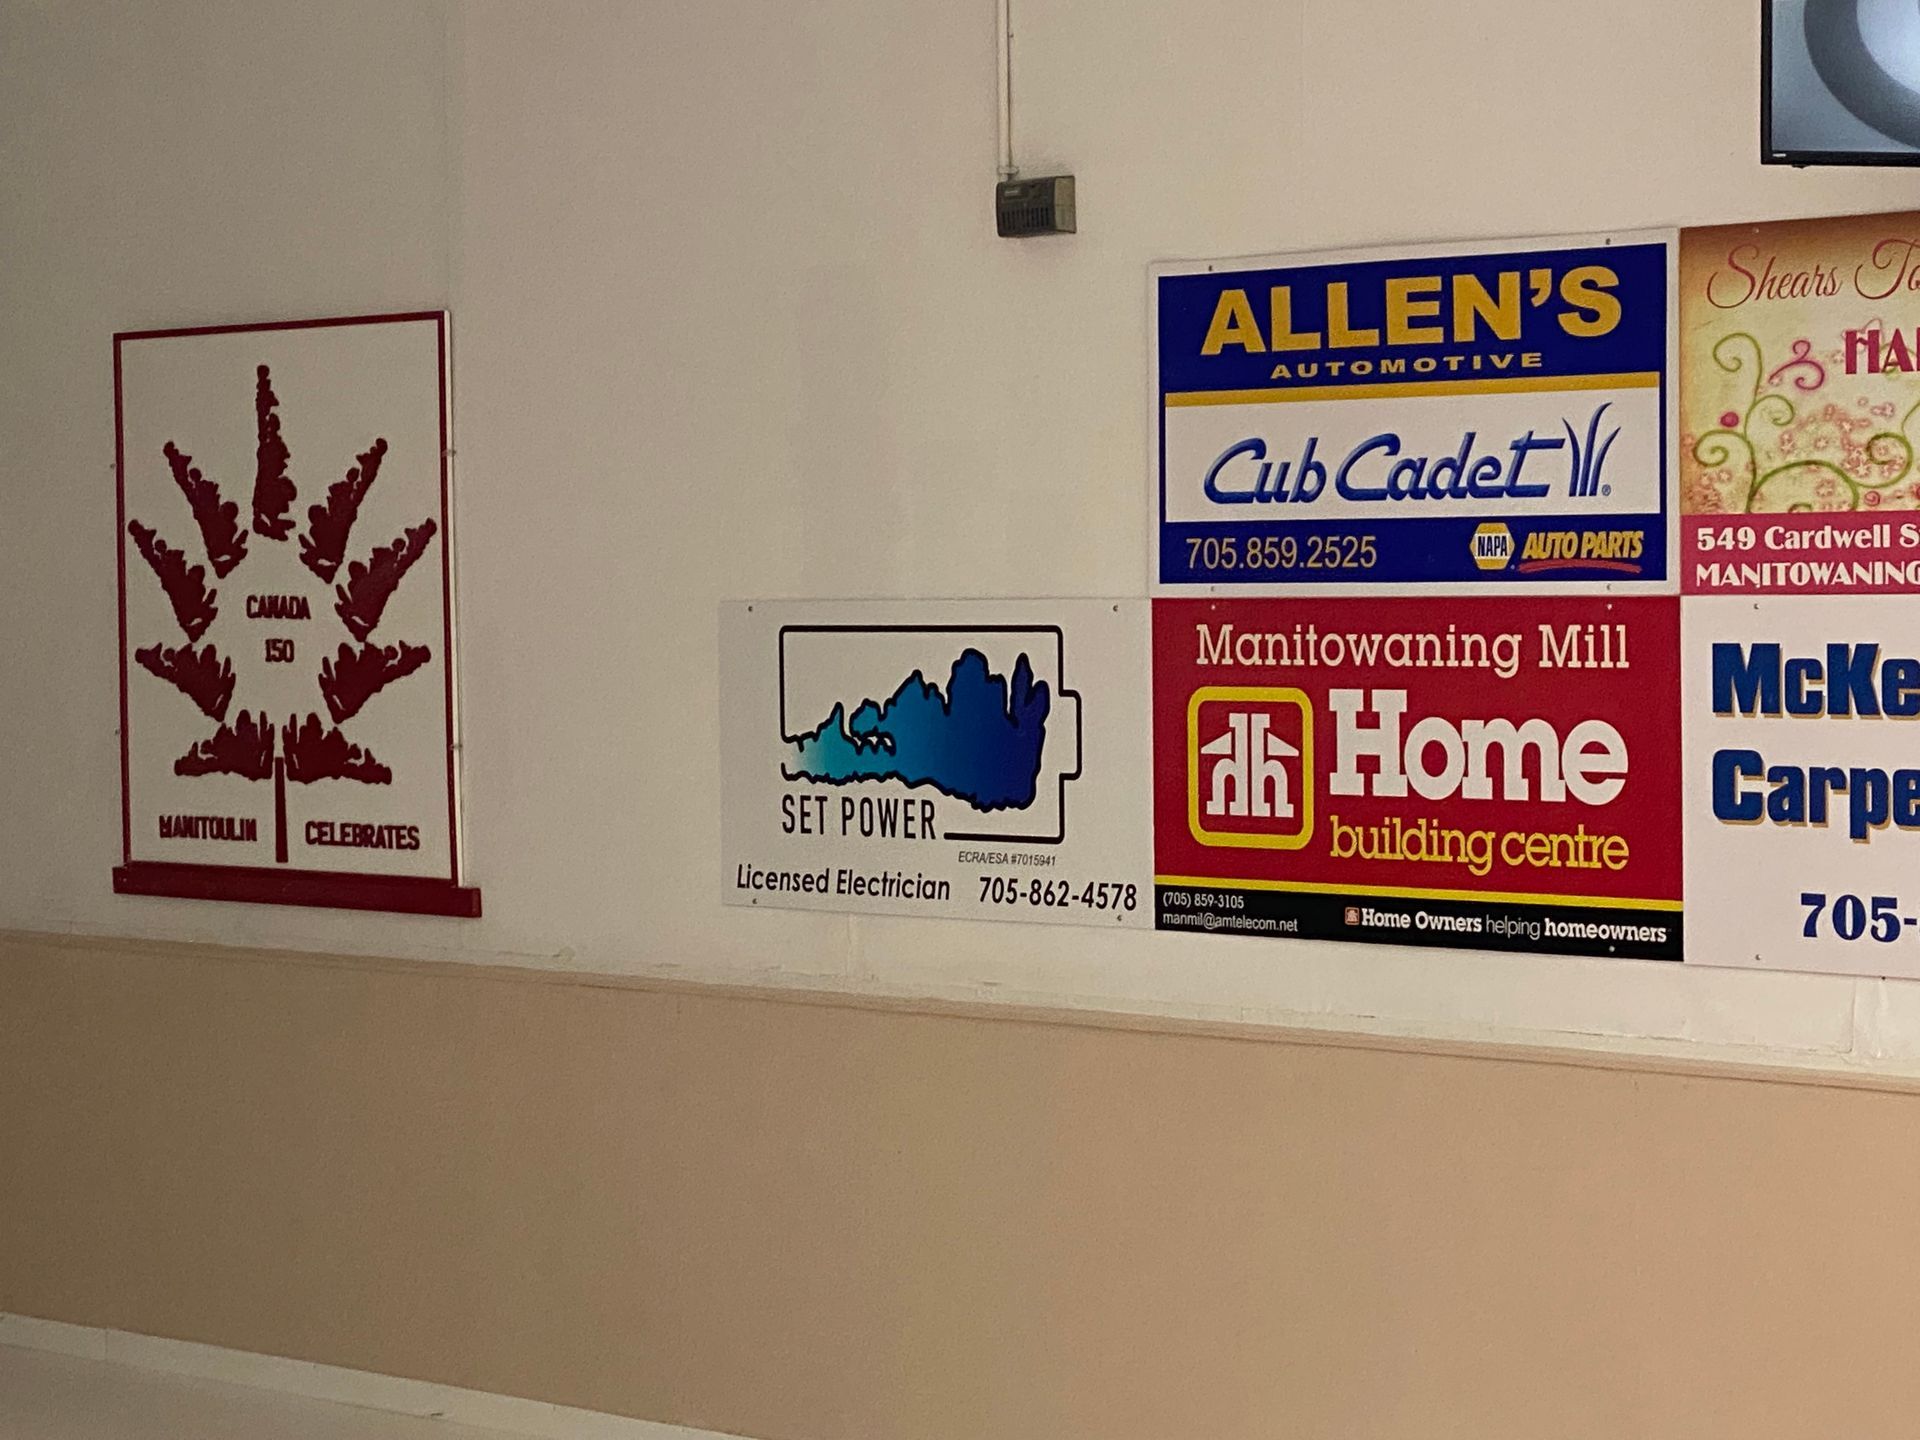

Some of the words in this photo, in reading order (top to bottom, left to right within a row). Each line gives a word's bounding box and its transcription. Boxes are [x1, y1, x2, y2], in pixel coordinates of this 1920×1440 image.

[1707, 244, 1843, 309] Shears
[1200, 265, 1623, 356] ALLEN'S
[1270, 352, 1543, 380] AUTOMOTIVE
[1844, 326, 1920, 375] HA
[1203, 437, 1327, 504] Cub
[1334, 430, 1566, 501] Cadet
[1186, 536, 1377, 569] 705.859.2525
[1477, 535, 1508, 557] NAPA
[1521, 532, 1579, 560] AUTO
[1580, 530, 1645, 559] PARTS
[1696, 527, 1756, 551] 549
[1764, 524, 1891, 550] Cardwell
[1899, 523, 1920, 548] S
[246, 595, 311, 620] CANADA
[265, 639, 295, 662] 150
[1196, 624, 1522, 678] Manitowaning
[1539, 624, 1629, 669] Mill
[1712, 643, 1920, 720] McKe
[1329, 689, 1629, 806] Home
[1712, 749, 1920, 843] Carpe
[159, 815, 257, 842] MANITOULIN
[781, 794, 828, 835] SET
[841, 797, 937, 840] POWER
[305, 821, 420, 850] CELEBRATES
[1330, 816, 1495, 876] building
[1501, 823, 1629, 870] centre
[958, 850, 1008, 865] ECRA/ESA
[1011, 853, 1056, 867] #7015941
[737, 864, 830, 895] Licensed
[836, 869, 951, 901] Electrician
[978, 876, 1138, 912] 705-862-4578
[1162, 891, 1192, 908] (705)
[1194, 893, 1245, 909] 859-3105
[1162, 912, 1299, 933] manmil@amtelecom.net
[1361, 907, 1411, 928] Home
[1415, 910, 1483, 933] Owners
[1485, 914, 1541, 941] helping
[1543, 917, 1668, 943] homeowners
[1801, 892, 1920, 943] 705-
